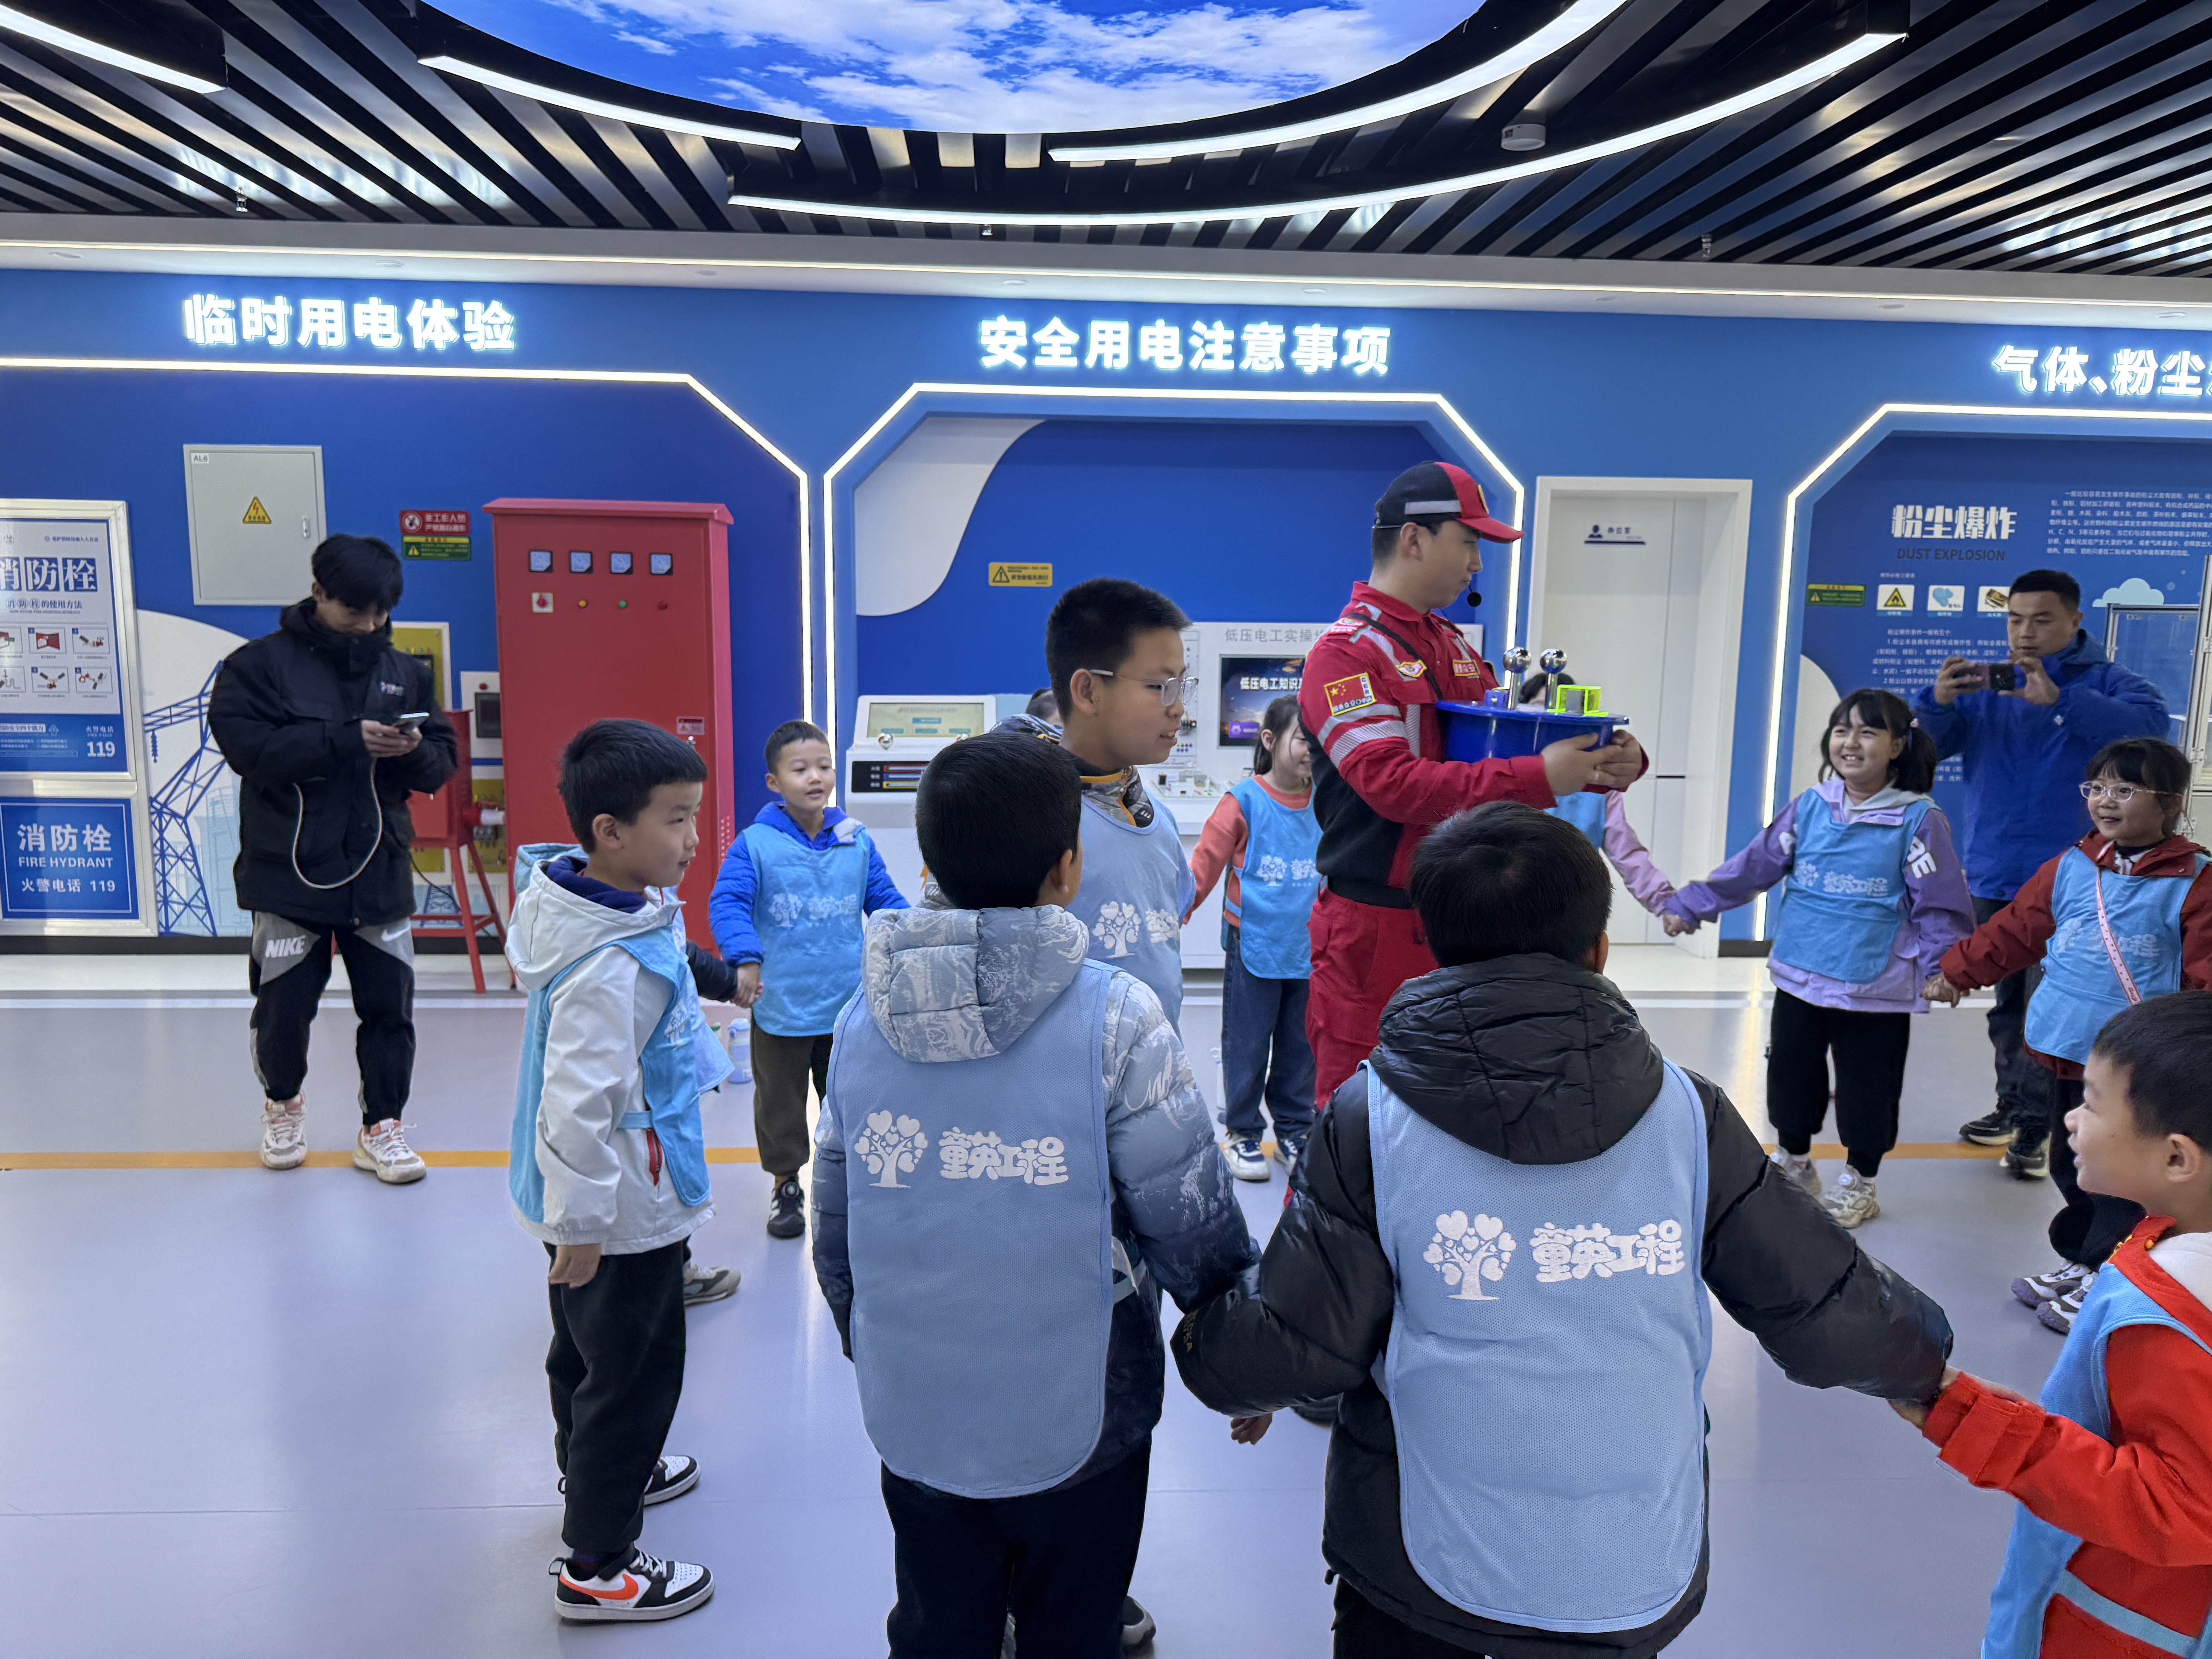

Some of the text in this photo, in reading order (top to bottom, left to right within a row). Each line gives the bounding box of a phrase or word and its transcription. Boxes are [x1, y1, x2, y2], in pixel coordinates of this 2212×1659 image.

[183, 293, 515, 352] 临时用电体验
[980, 314, 1391, 375] 安全用电注意事项
[1992, 345, 2212, 397] 气体、粉尘
[1891, 505, 2017, 539] 粉尘爆炸
[1897, 548, 2006, 561] DUST EXPLOSION
[1240, 677, 1302, 690] 低压电工知识
[87, 740, 115, 757] 119
[17, 823, 112, 853] 消防栓
[19, 856, 113, 869] FIRE HYDRANT
[21, 878, 115, 893] 火警电话 119
[265, 939, 306, 958] NIKE
[939, 1127, 1069, 1186] 童英工程
[1530, 1222, 1685, 1283] 童英工程
